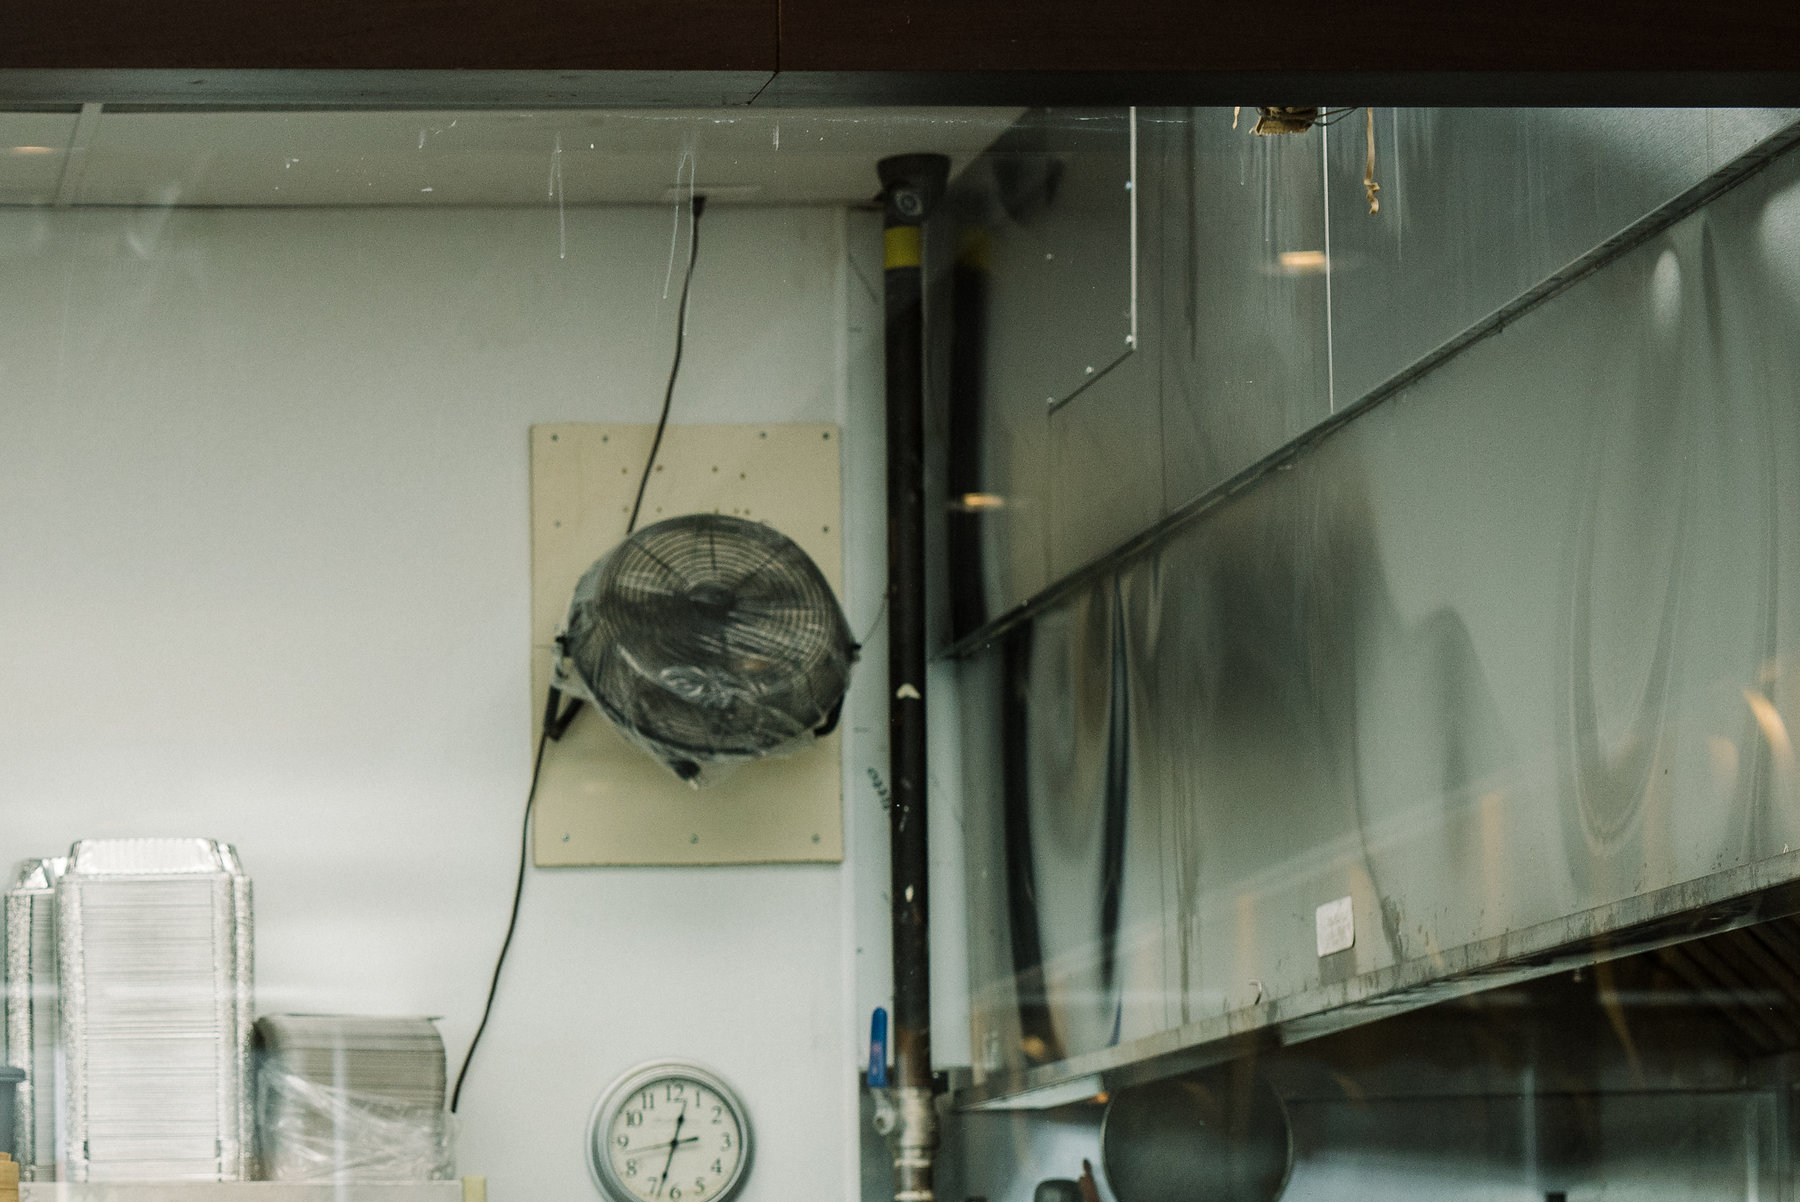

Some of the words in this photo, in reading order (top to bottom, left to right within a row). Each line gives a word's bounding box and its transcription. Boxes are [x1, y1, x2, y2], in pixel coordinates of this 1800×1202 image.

[641, 1090, 655, 1110] 11
[666, 1083, 685, 1103] 12
[625, 1110, 643, 1128] 10
[711, 1105, 723, 1125] 2
[617, 1134, 629, 1148] 9
[721, 1131, 732, 1152] 3
[625, 1159, 637, 1177] 8
[711, 1158, 722, 1174] 4
[647, 1176, 658, 1197] 7
[669, 1186, 682, 1200] 6
[694, 1176, 705, 1195] 5
